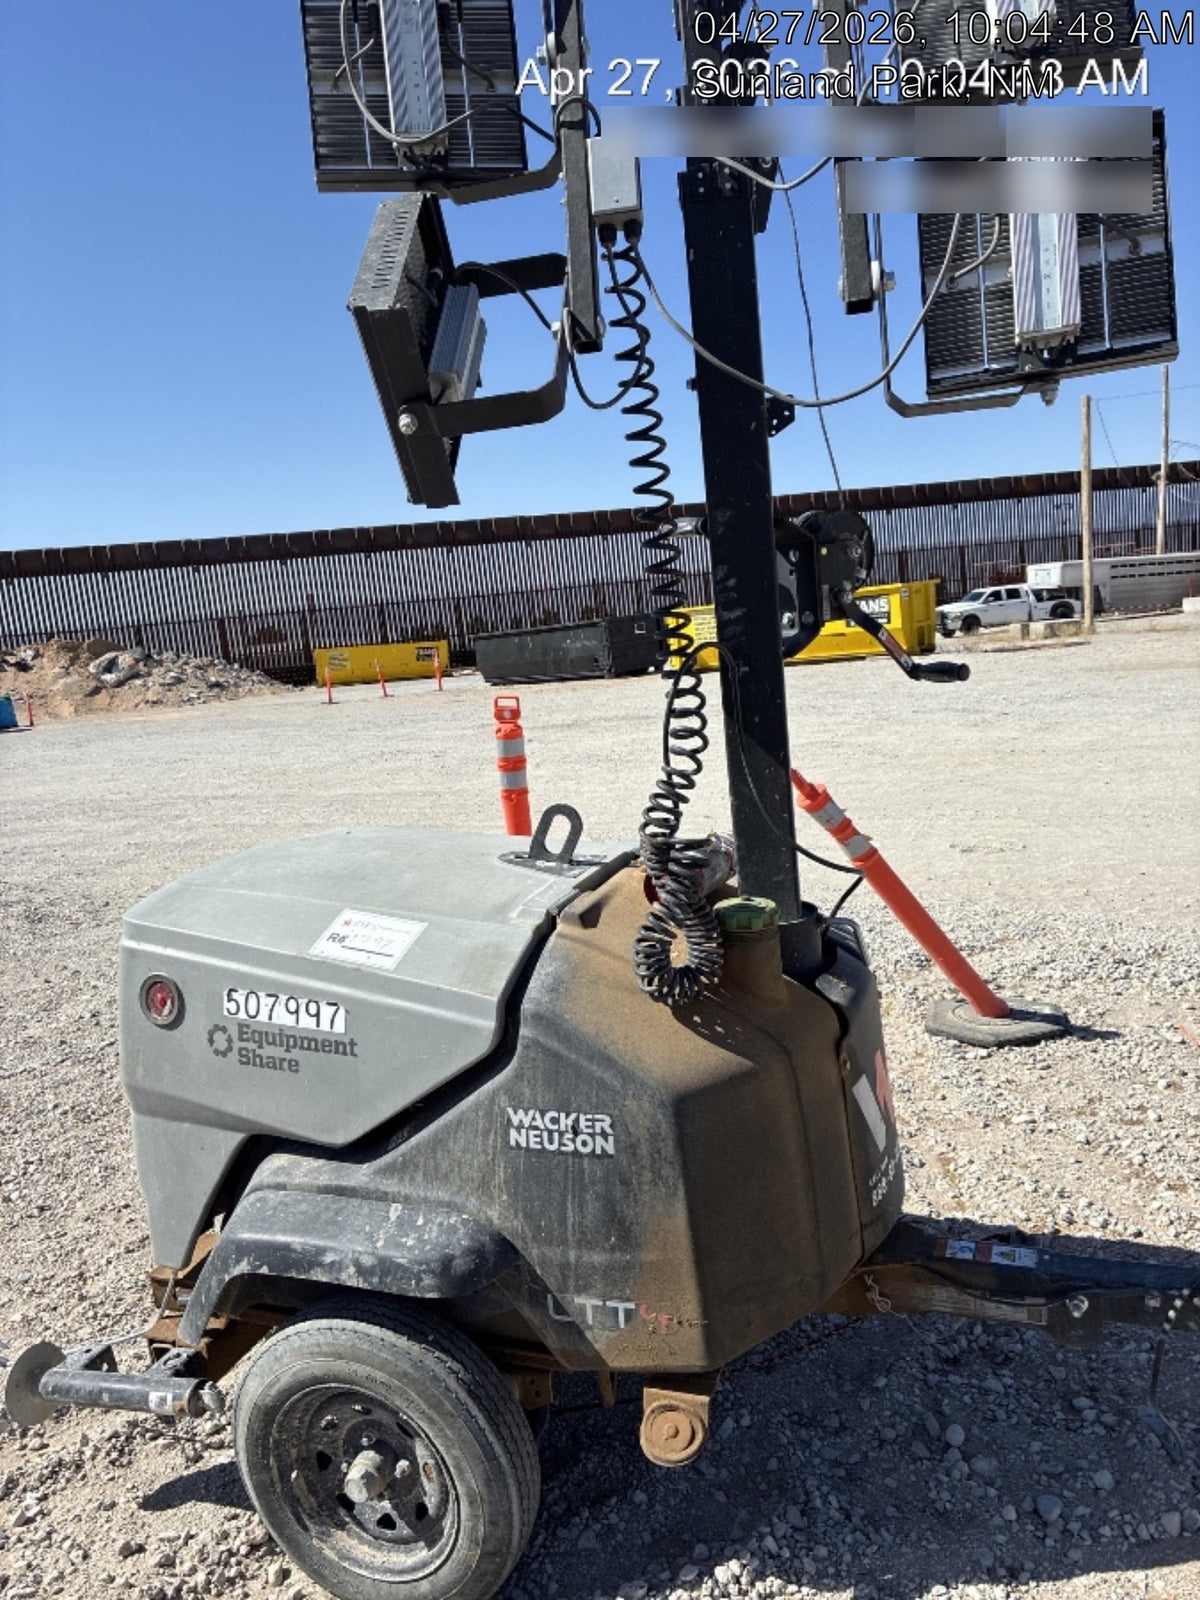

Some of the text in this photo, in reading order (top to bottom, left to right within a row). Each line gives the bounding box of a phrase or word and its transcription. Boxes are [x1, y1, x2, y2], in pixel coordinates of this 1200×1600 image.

[226, 987, 341, 1030] 507997
[237, 1022, 358, 1057] Equipment
[237, 1046, 300, 1073] Share
[506, 1107, 614, 1134] WACKER
[509, 1128, 616, 1154] NEUSON
